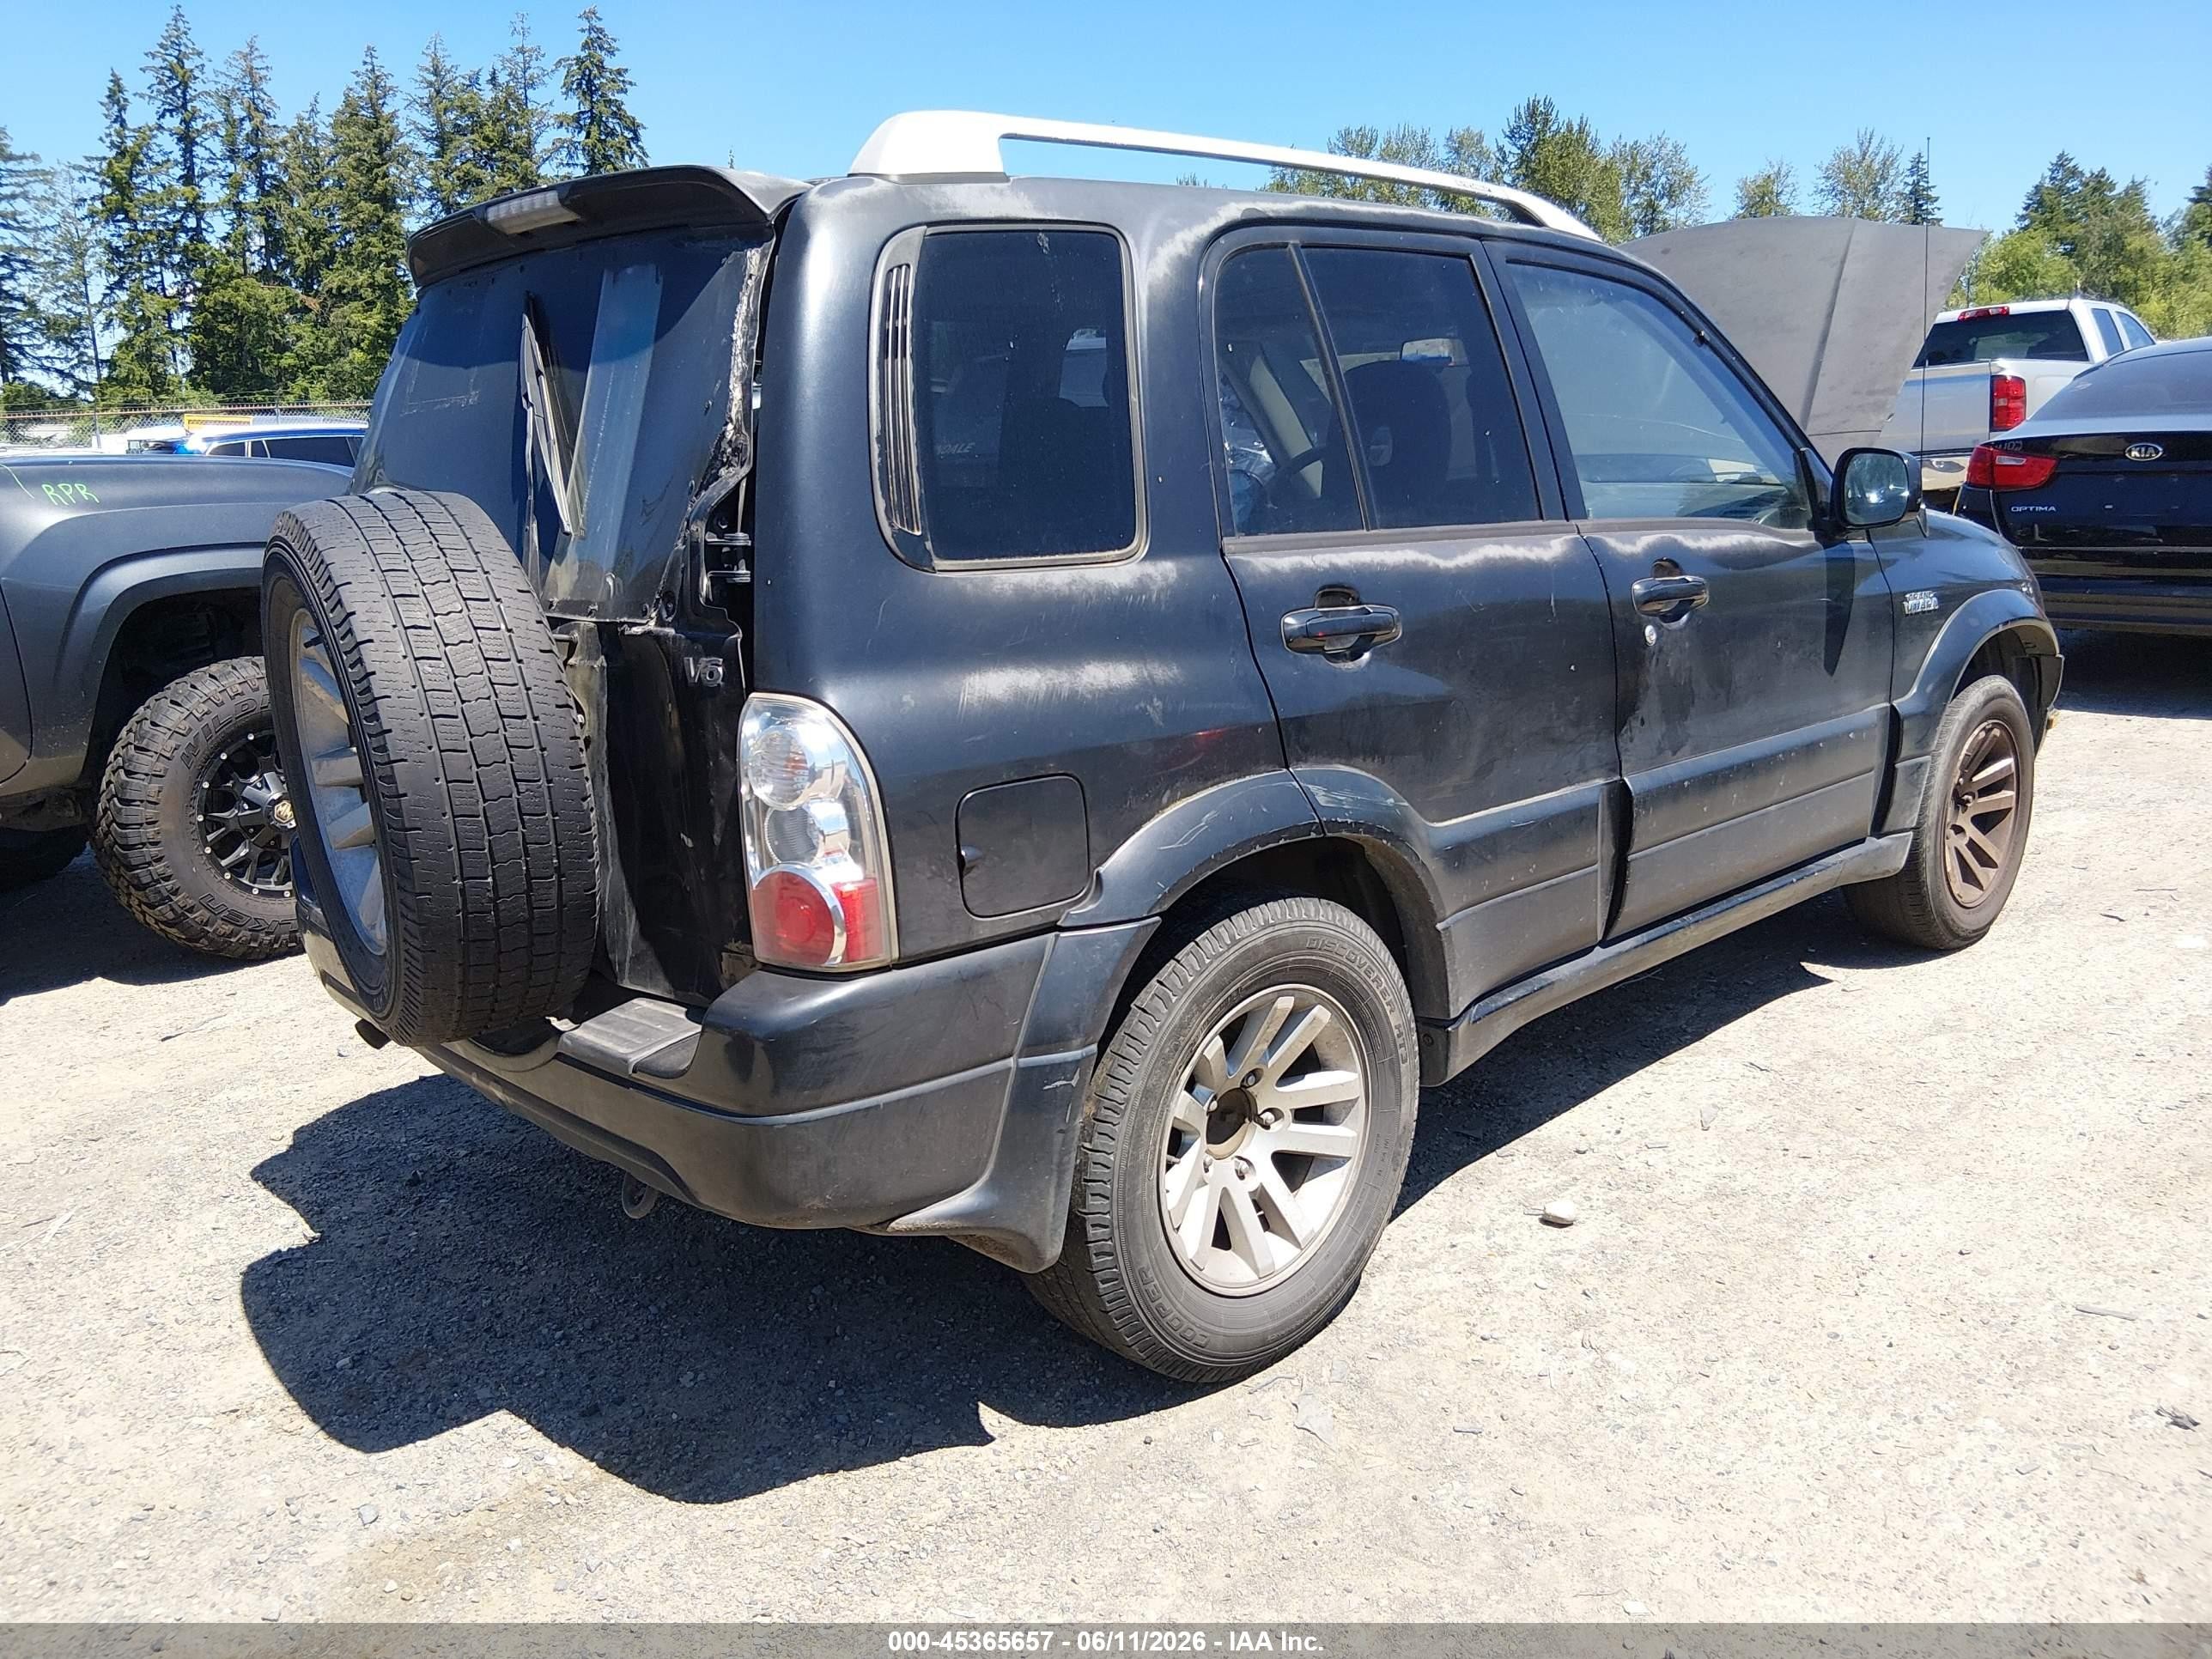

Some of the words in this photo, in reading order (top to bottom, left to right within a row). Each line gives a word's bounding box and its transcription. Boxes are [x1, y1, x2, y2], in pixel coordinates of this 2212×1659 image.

[2130, 447, 2156, 458] KIA
[41, 483, 100, 506] RPR
[684, 656, 724, 687] V6
[199, 893, 299, 933] LKEN
[1305, 936, 1397, 1016] DISCOVERER
[1138, 1265, 1210, 1349] COOPER
